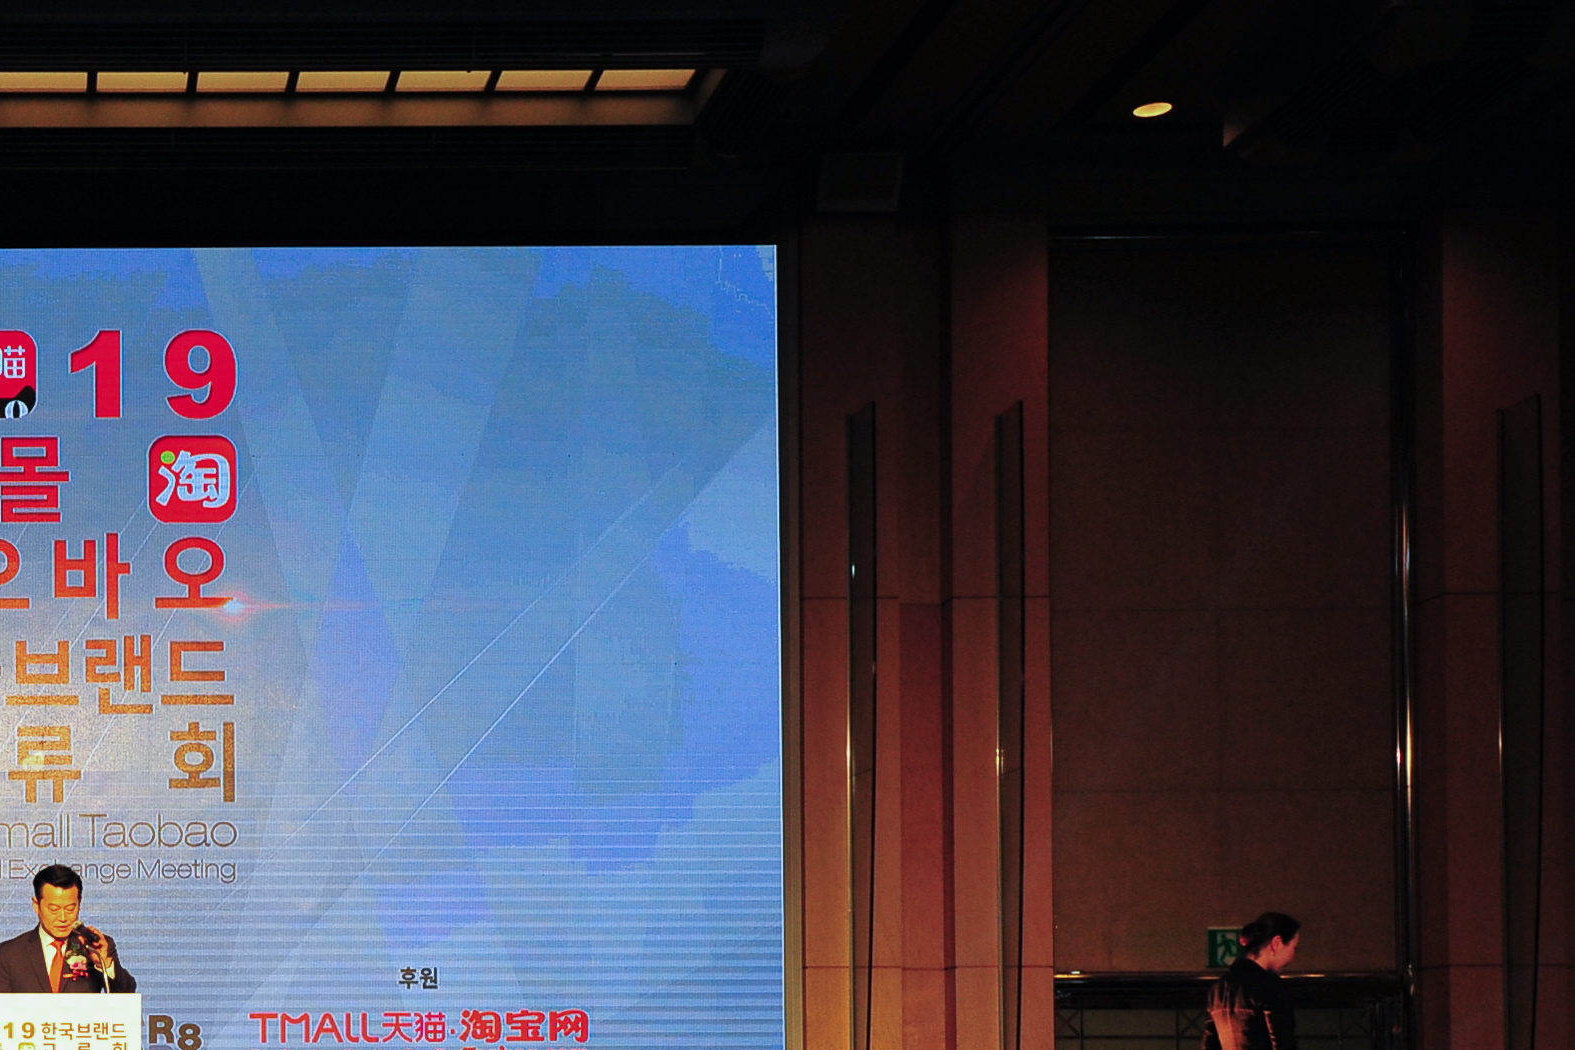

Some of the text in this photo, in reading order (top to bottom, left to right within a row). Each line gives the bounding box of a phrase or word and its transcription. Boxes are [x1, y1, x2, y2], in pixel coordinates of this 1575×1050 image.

[155, 449, 232, 508] 淘
[78, 812, 238, 849] Taobao
[9, 859, 132, 884] Exange
[137, 858, 237, 884] Meeting
[398, 966, 439, 990] 후원
[41, 1021, 127, 1041] 한국브랜드
